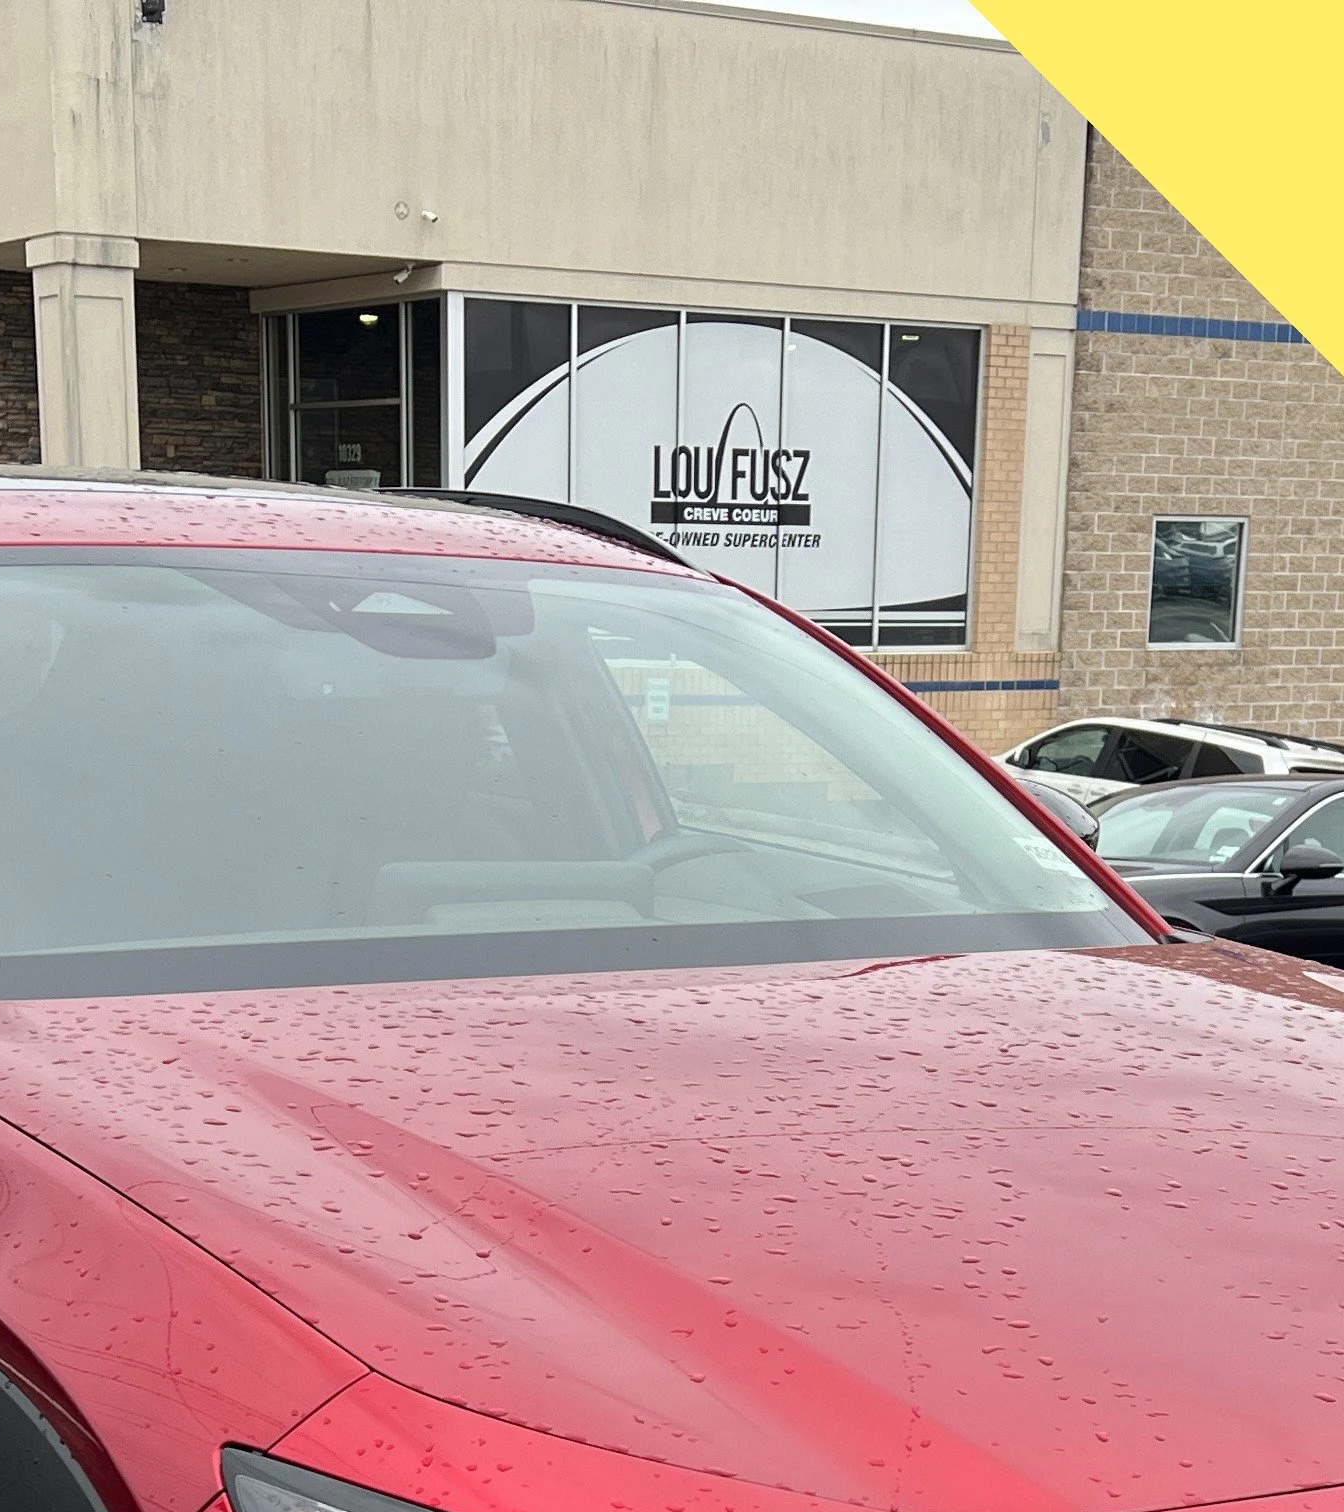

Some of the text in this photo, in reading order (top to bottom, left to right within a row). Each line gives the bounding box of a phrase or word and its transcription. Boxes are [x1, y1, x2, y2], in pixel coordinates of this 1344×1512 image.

[653, 444, 811, 502] LOU FUSZ
[683, 507, 779, 523] CREVE COEUR
